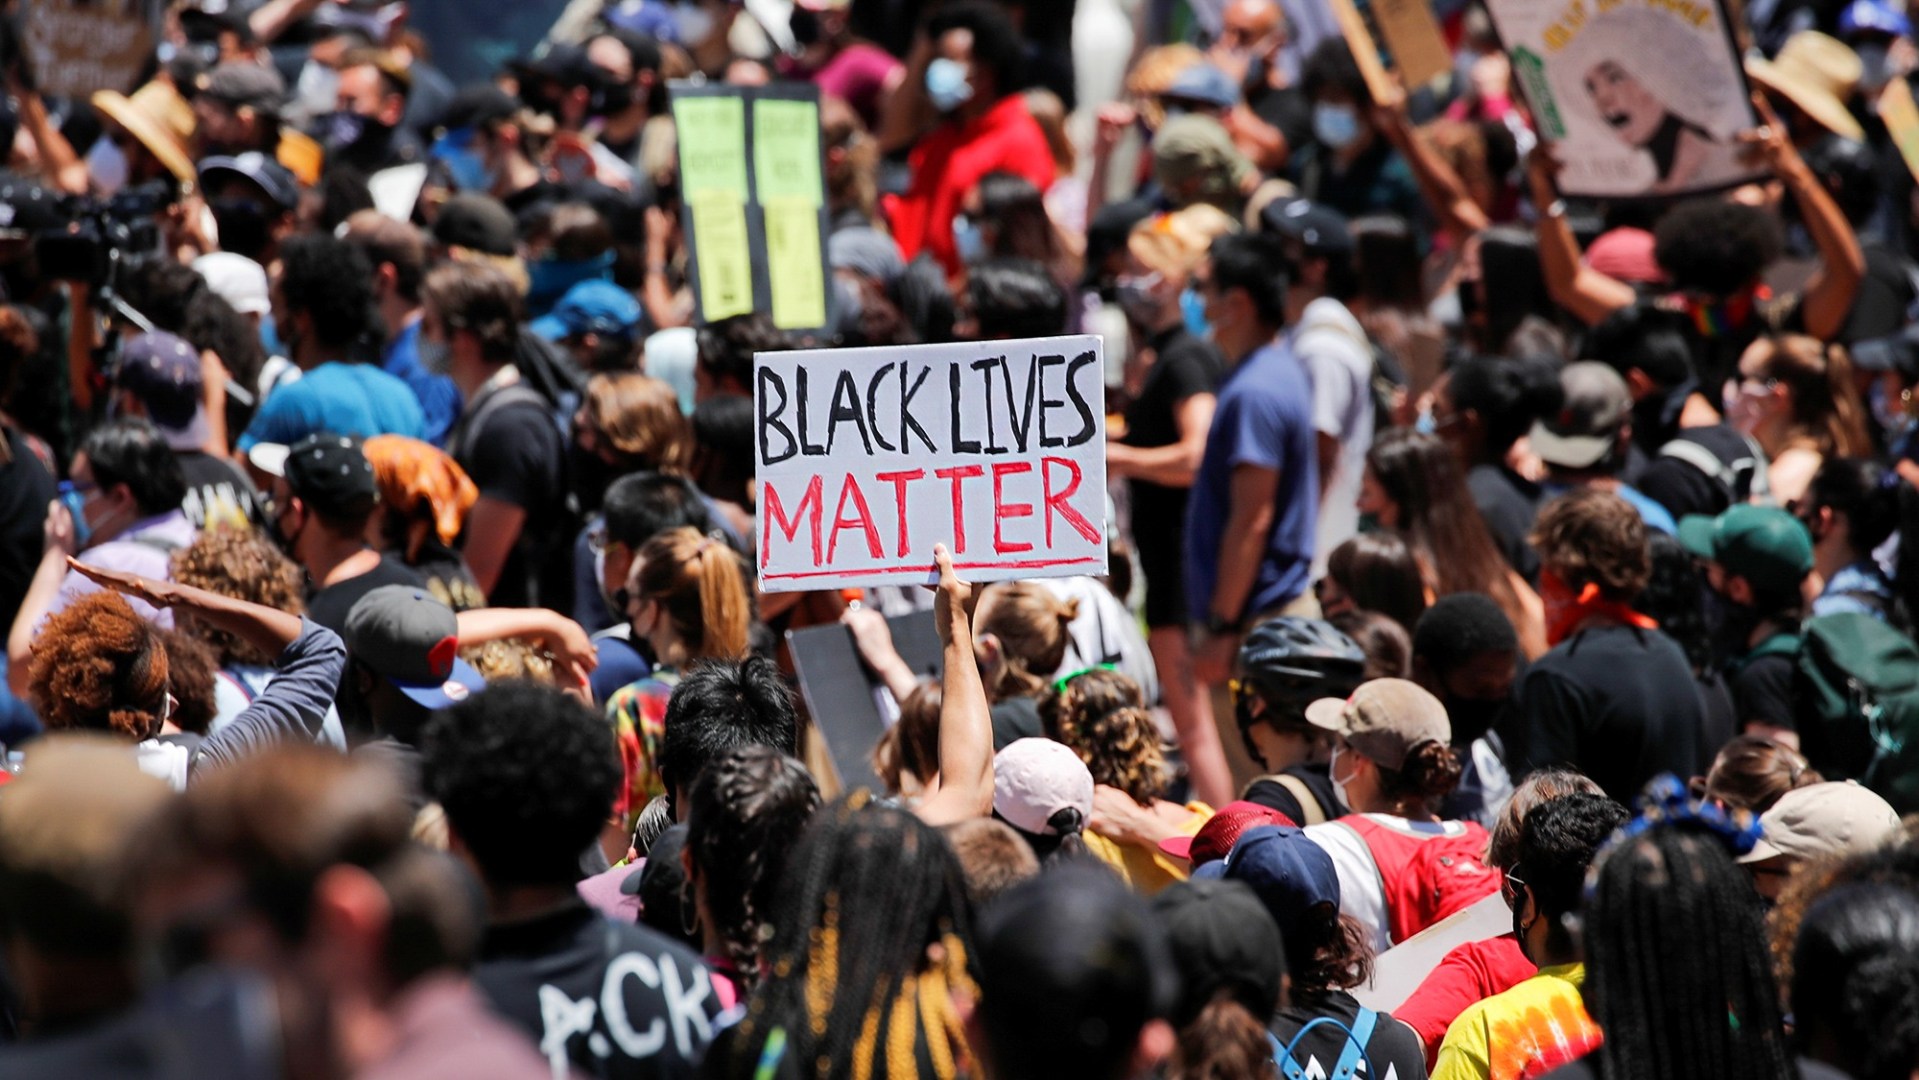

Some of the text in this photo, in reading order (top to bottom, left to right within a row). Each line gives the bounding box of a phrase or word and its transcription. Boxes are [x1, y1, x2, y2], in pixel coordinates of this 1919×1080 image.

[758, 350, 1096, 466] BLACK LIVES
[761, 456, 1102, 569] MATTER
